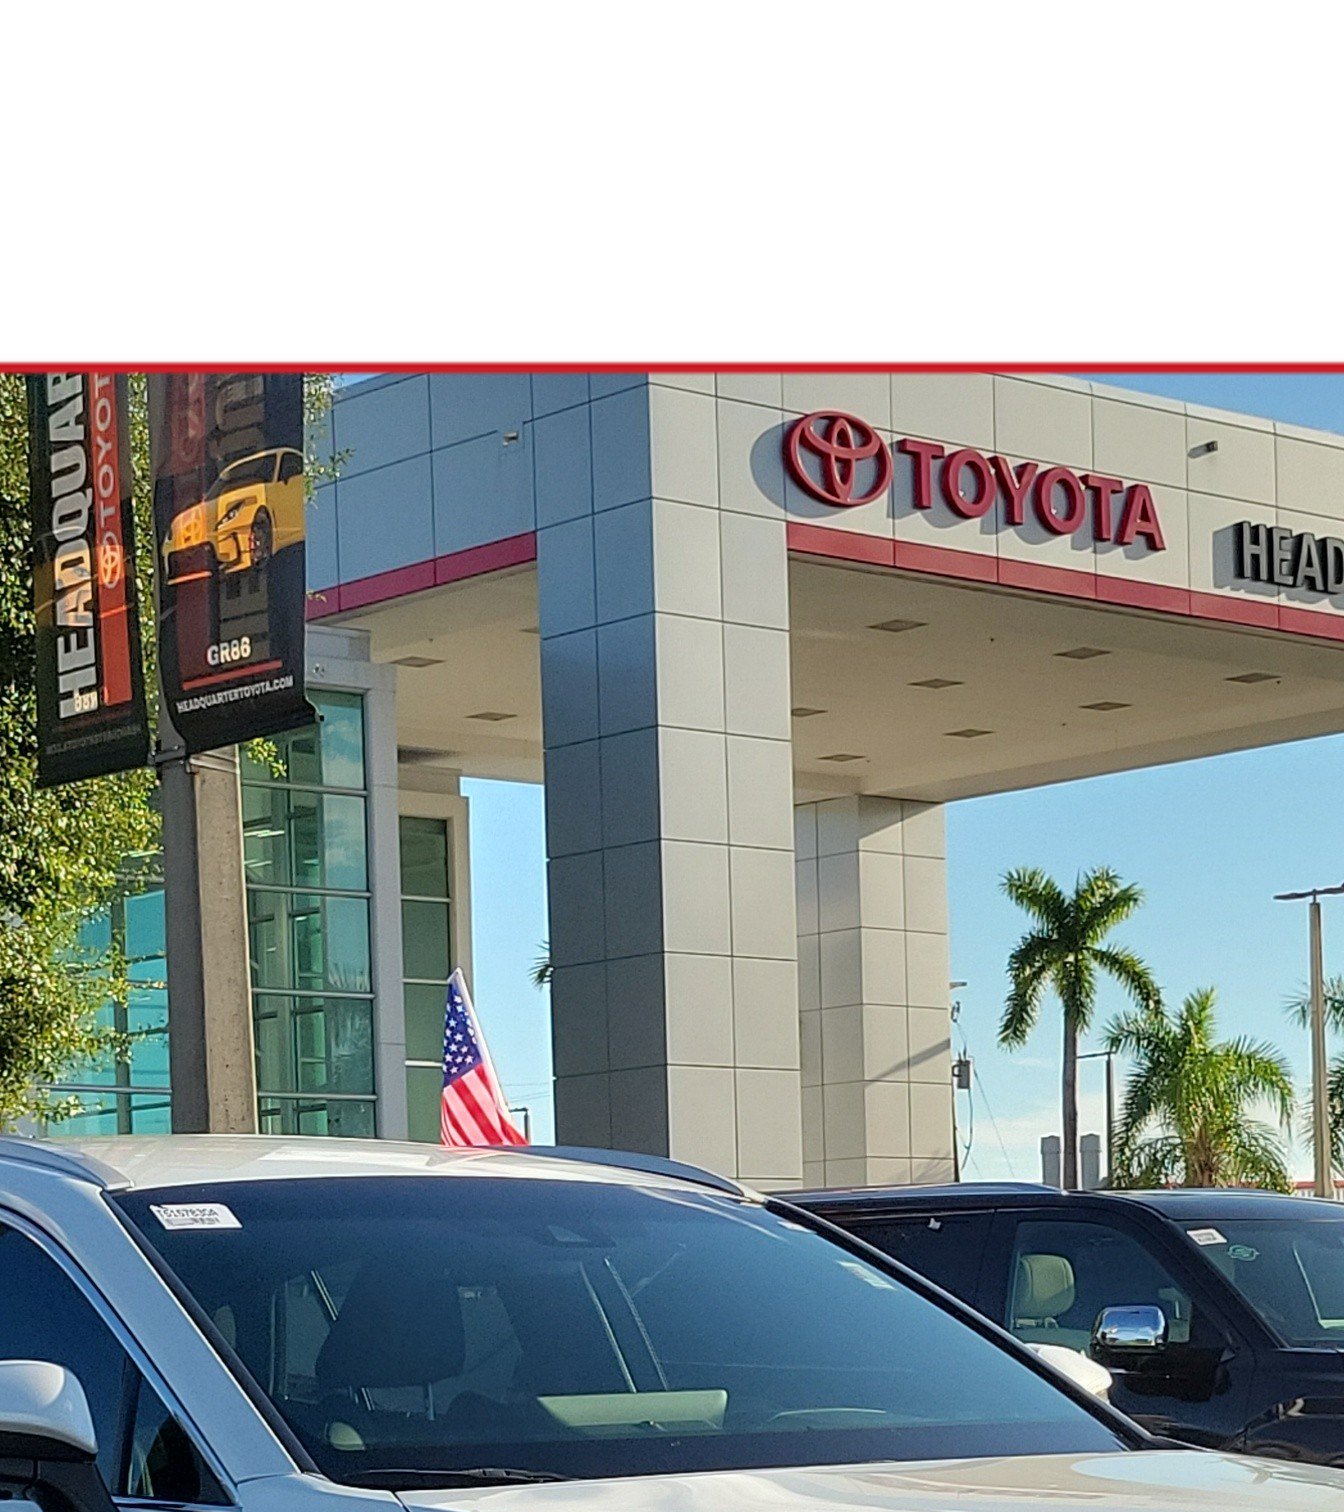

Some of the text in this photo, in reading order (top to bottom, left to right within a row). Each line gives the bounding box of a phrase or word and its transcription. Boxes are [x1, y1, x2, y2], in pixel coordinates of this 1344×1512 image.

[899, 437, 1167, 551] TOYOTA
[206, 636, 251, 666] GR86
[176, 675, 294, 714] HEADQUARTERTOYOTA.COM
